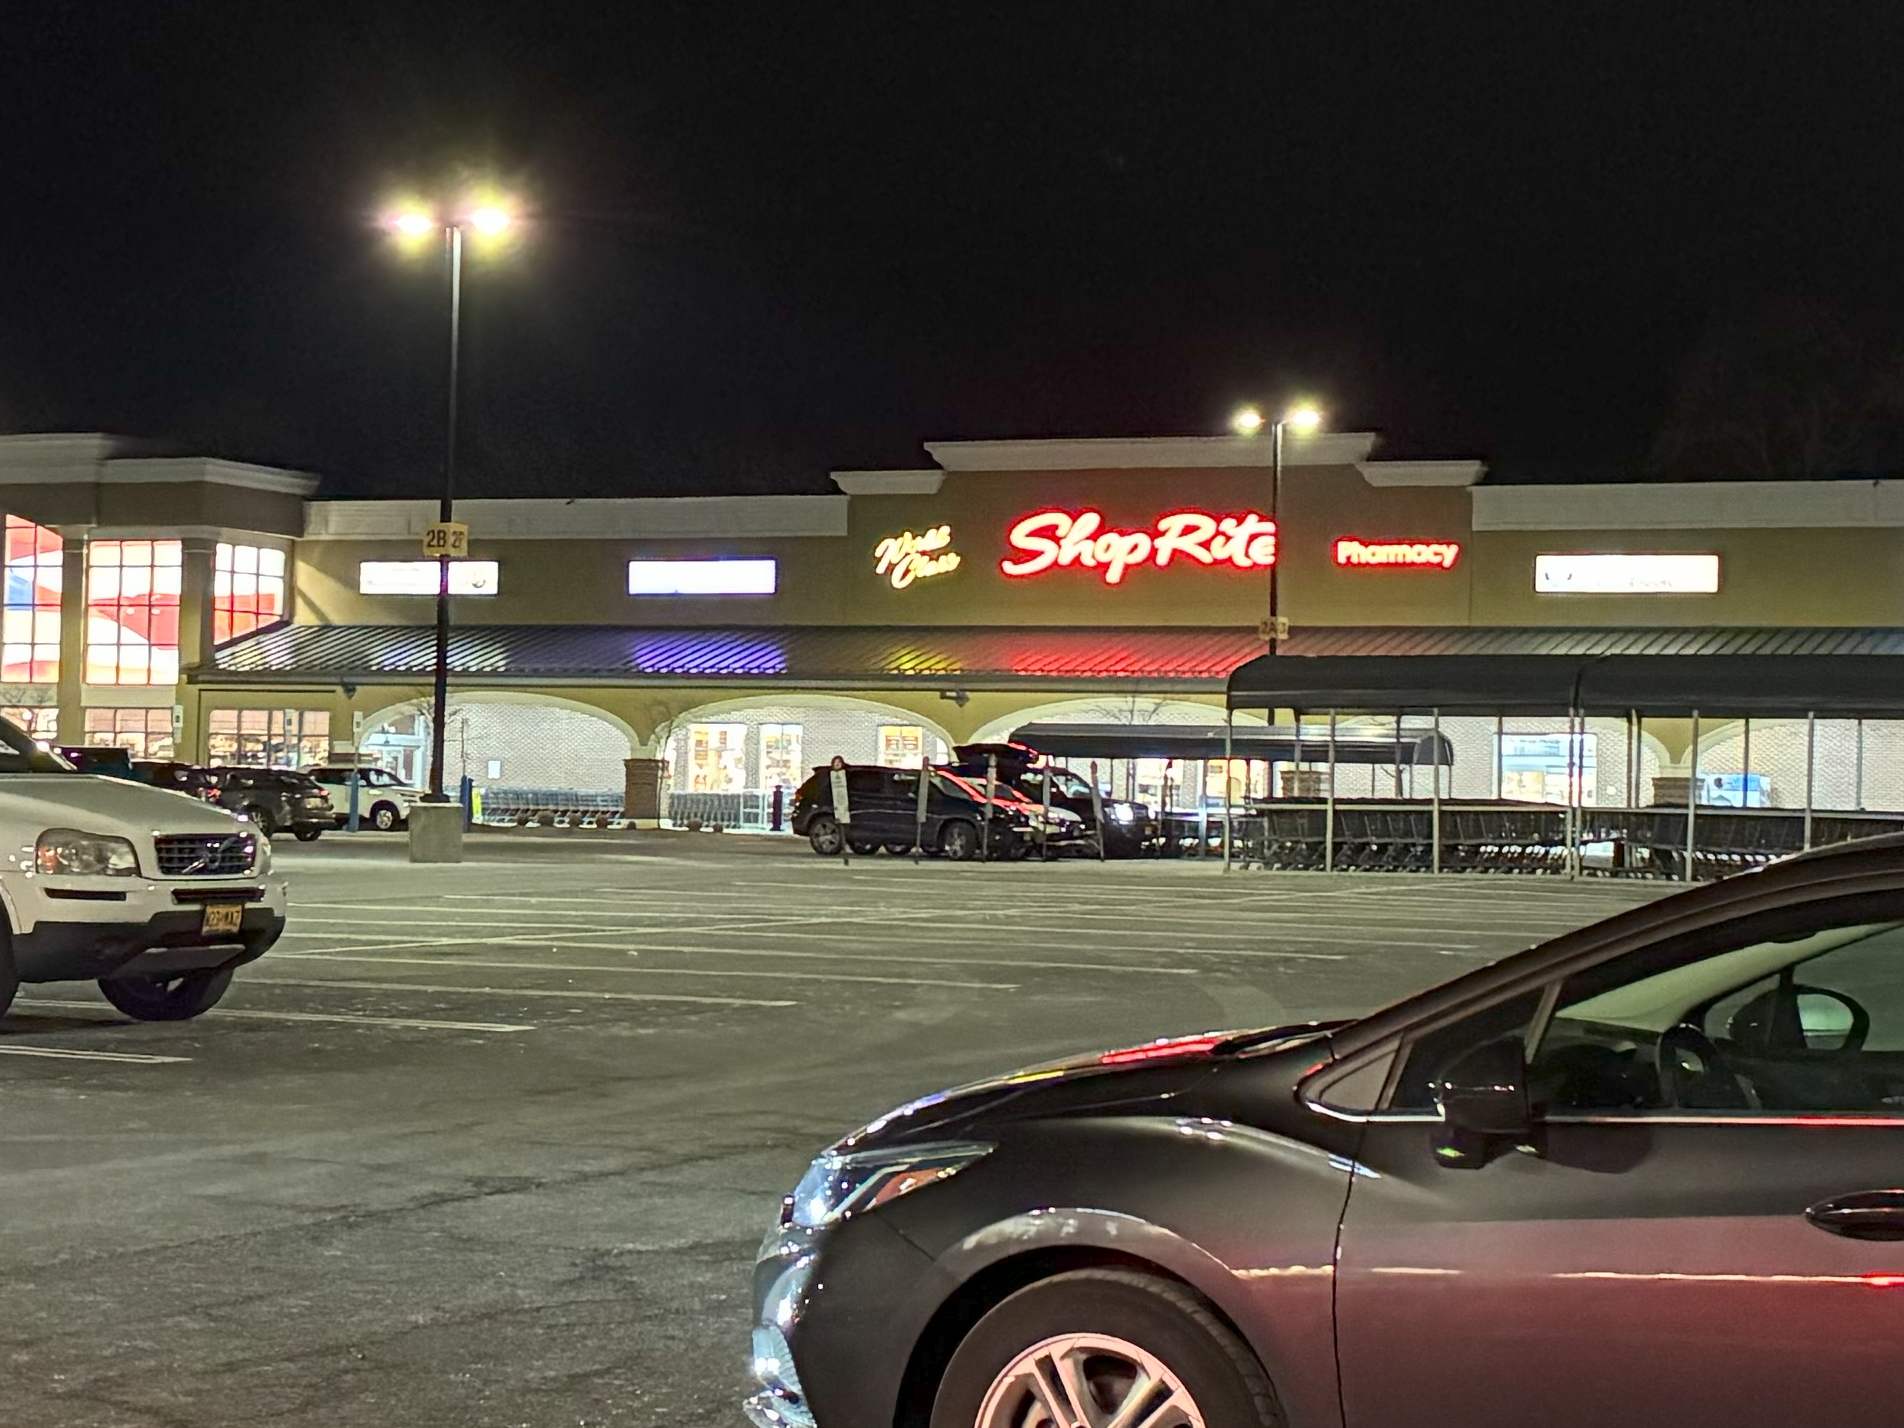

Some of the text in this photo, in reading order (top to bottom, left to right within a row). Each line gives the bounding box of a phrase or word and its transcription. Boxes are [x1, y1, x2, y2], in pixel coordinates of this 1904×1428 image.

[426, 529, 447, 548] 2B
[1000, 510, 1276, 585] ShopRite
[1336, 540, 1459, 568] Pharmacy
